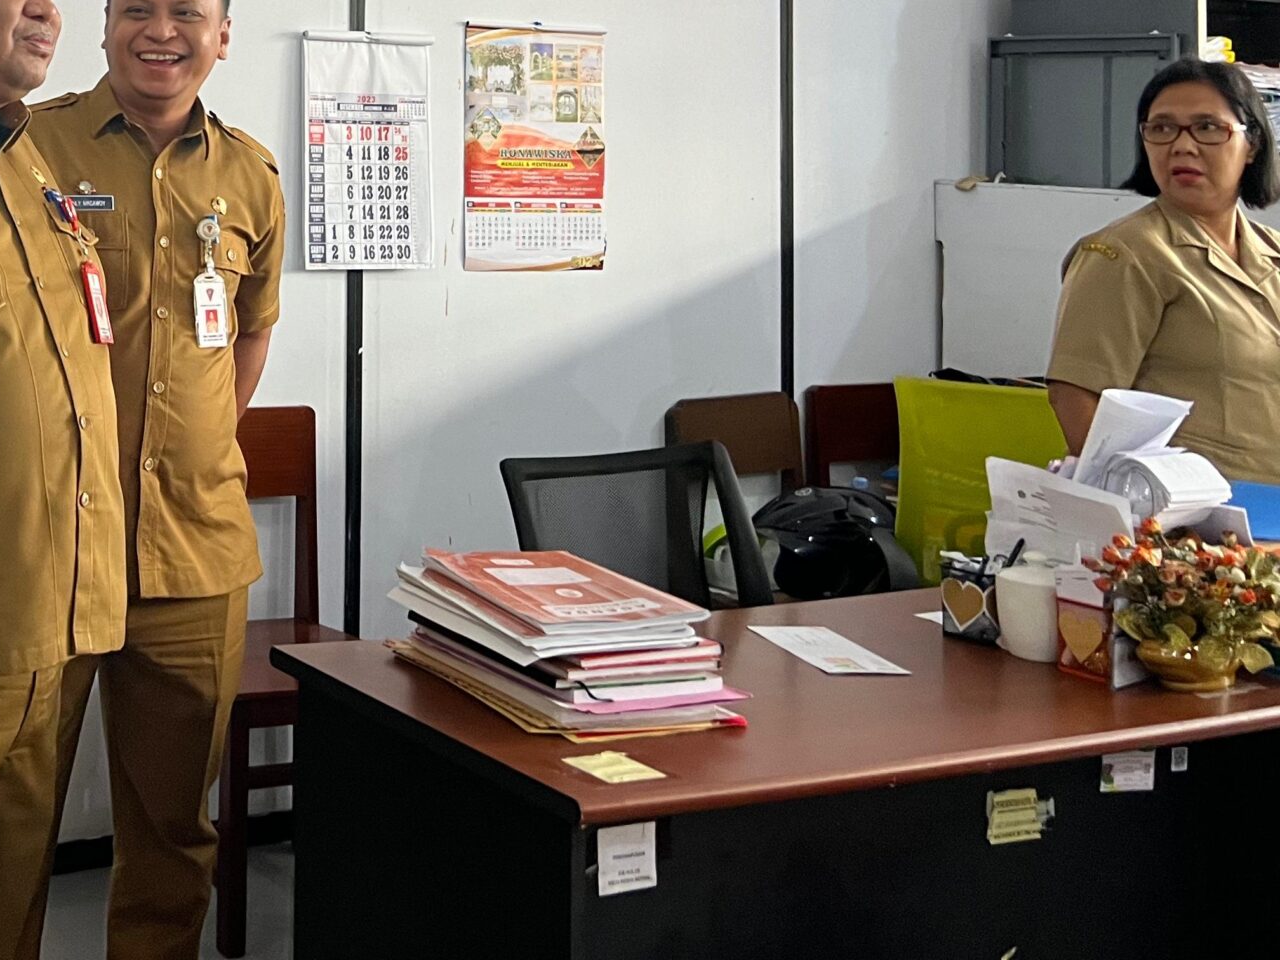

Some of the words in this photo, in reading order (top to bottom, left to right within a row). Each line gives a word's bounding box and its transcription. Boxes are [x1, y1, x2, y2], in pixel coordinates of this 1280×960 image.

[346, 126, 353, 140] 3
[360, 126, 372, 141] 10
[378, 126, 390, 141] 17
[346, 145, 353, 160] 4
[362, 145, 371, 160] 11
[378, 145, 390, 160] 18
[395, 146, 408, 161] 25
[346, 165, 353, 180] 5
[361, 165, 373, 180] 12
[378, 165, 390, 180] 19
[395, 166, 408, 180] 26
[347, 185, 354, 200] 6
[362, 185, 373, 200] 13
[378, 185, 392, 200] 20
[395, 185, 408, 200] 27
[347, 205, 354, 220] 7
[362, 205, 374, 220] 14
[380, 205, 391, 220] 21
[396, 205, 409, 220] 28
[332, 224, 337, 239] 1
[348, 224, 355, 239] 8
[363, 224, 374, 239] 15
[379, 225, 392, 240] 22
[396, 225, 410, 240] 29
[332, 244, 339, 259] 2
[349, 244, 356, 259] 9
[364, 244, 375, 260] 16
[380, 244, 393, 259] 23
[397, 244, 411, 259] 30
